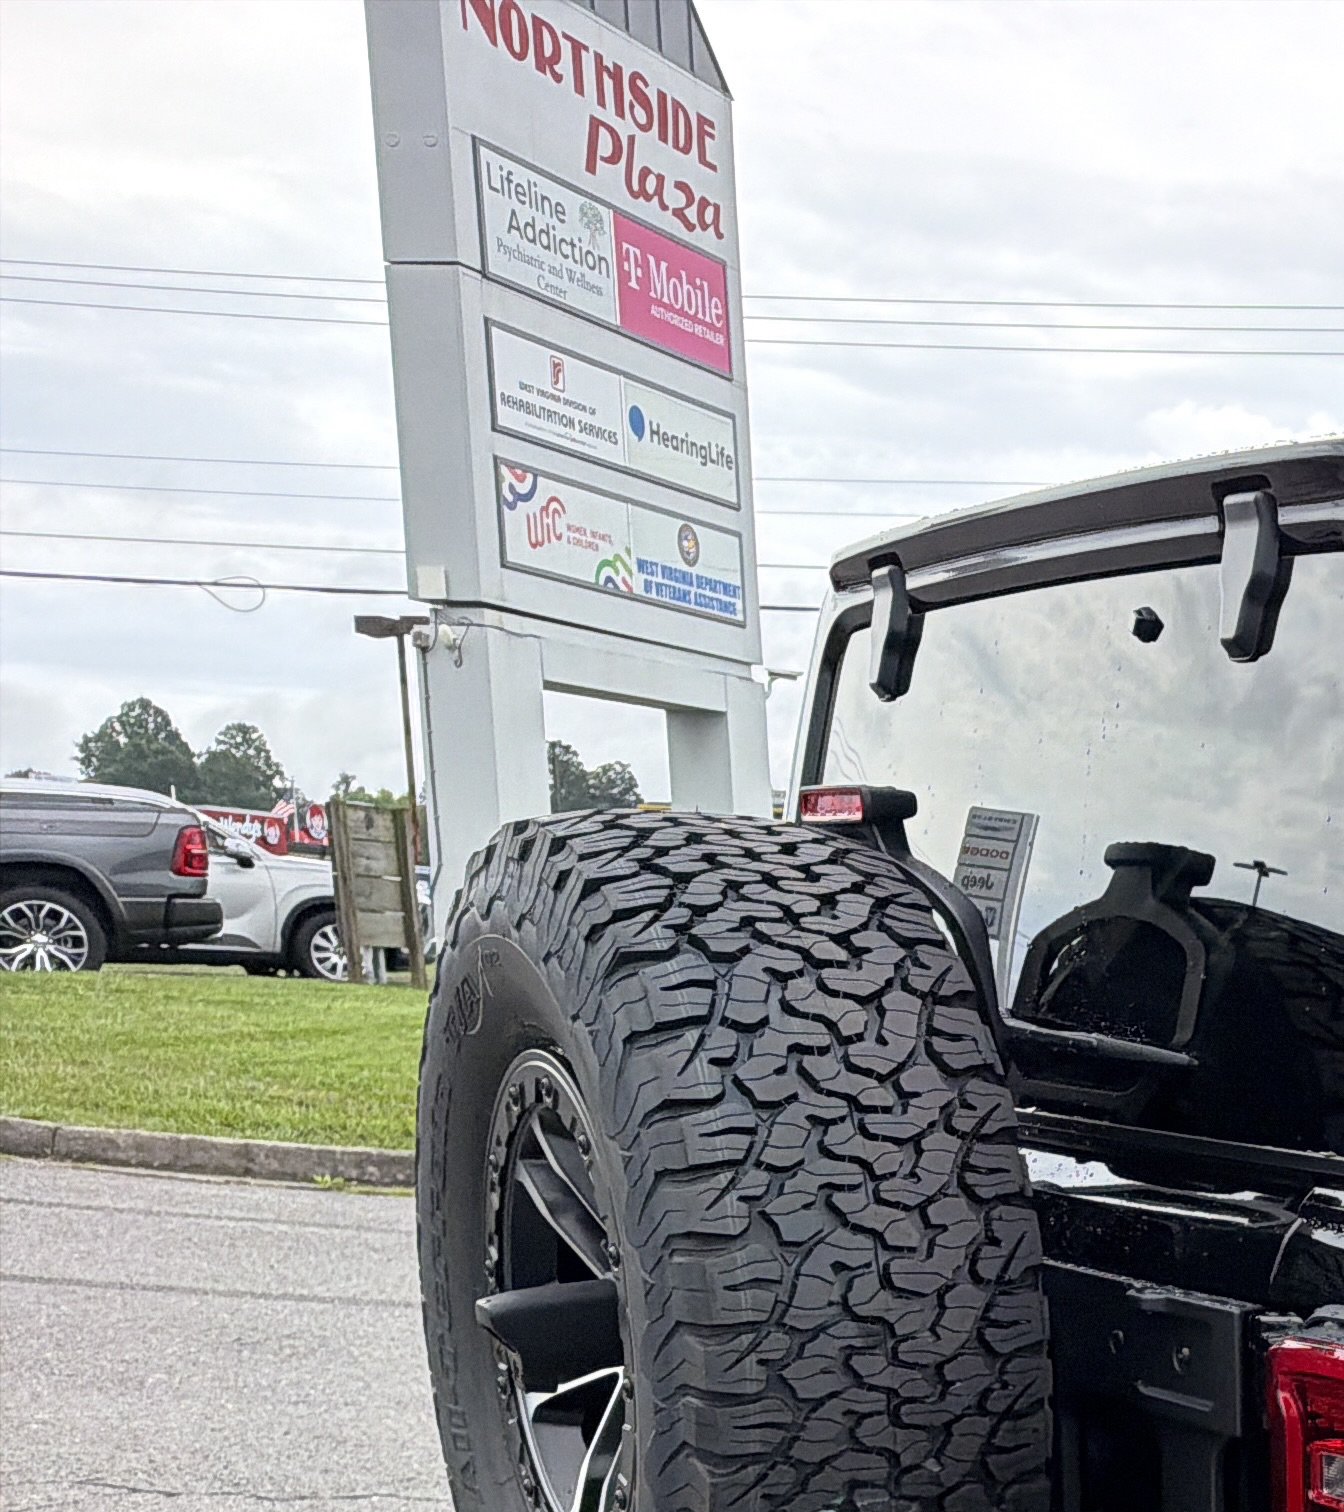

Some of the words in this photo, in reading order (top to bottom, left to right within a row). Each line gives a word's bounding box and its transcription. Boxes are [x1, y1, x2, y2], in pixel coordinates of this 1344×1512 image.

[459, 0, 718, 173] NORTHSIDE
[486, 161, 566, 224] Lifeline
[585, 114, 724, 240] Plaza
[496, 236, 546, 272] Psychiatric
[547, 263, 564, 280] and
[565, 267, 604, 297] Wellness
[507, 208, 610, 279] Addiction
[537, 274, 567, 300] Center
[650, 304, 693, 333] AUTHORIZED
[693, 322, 725, 346] RETAILER
[499, 391, 576, 431] REHABILITATION
[577, 418, 619, 445] SERVICES
[648, 419, 734, 471] HearingLife
[636, 557, 659, 578] WEST
[660, 563, 694, 587] VIRGINIA
[695, 573, 741, 600] DEPARTMENT
[643, 578, 653, 594] OF
[654, 581, 692, 605] VETERANS
[693, 591, 738, 617] ASSISTANCE
